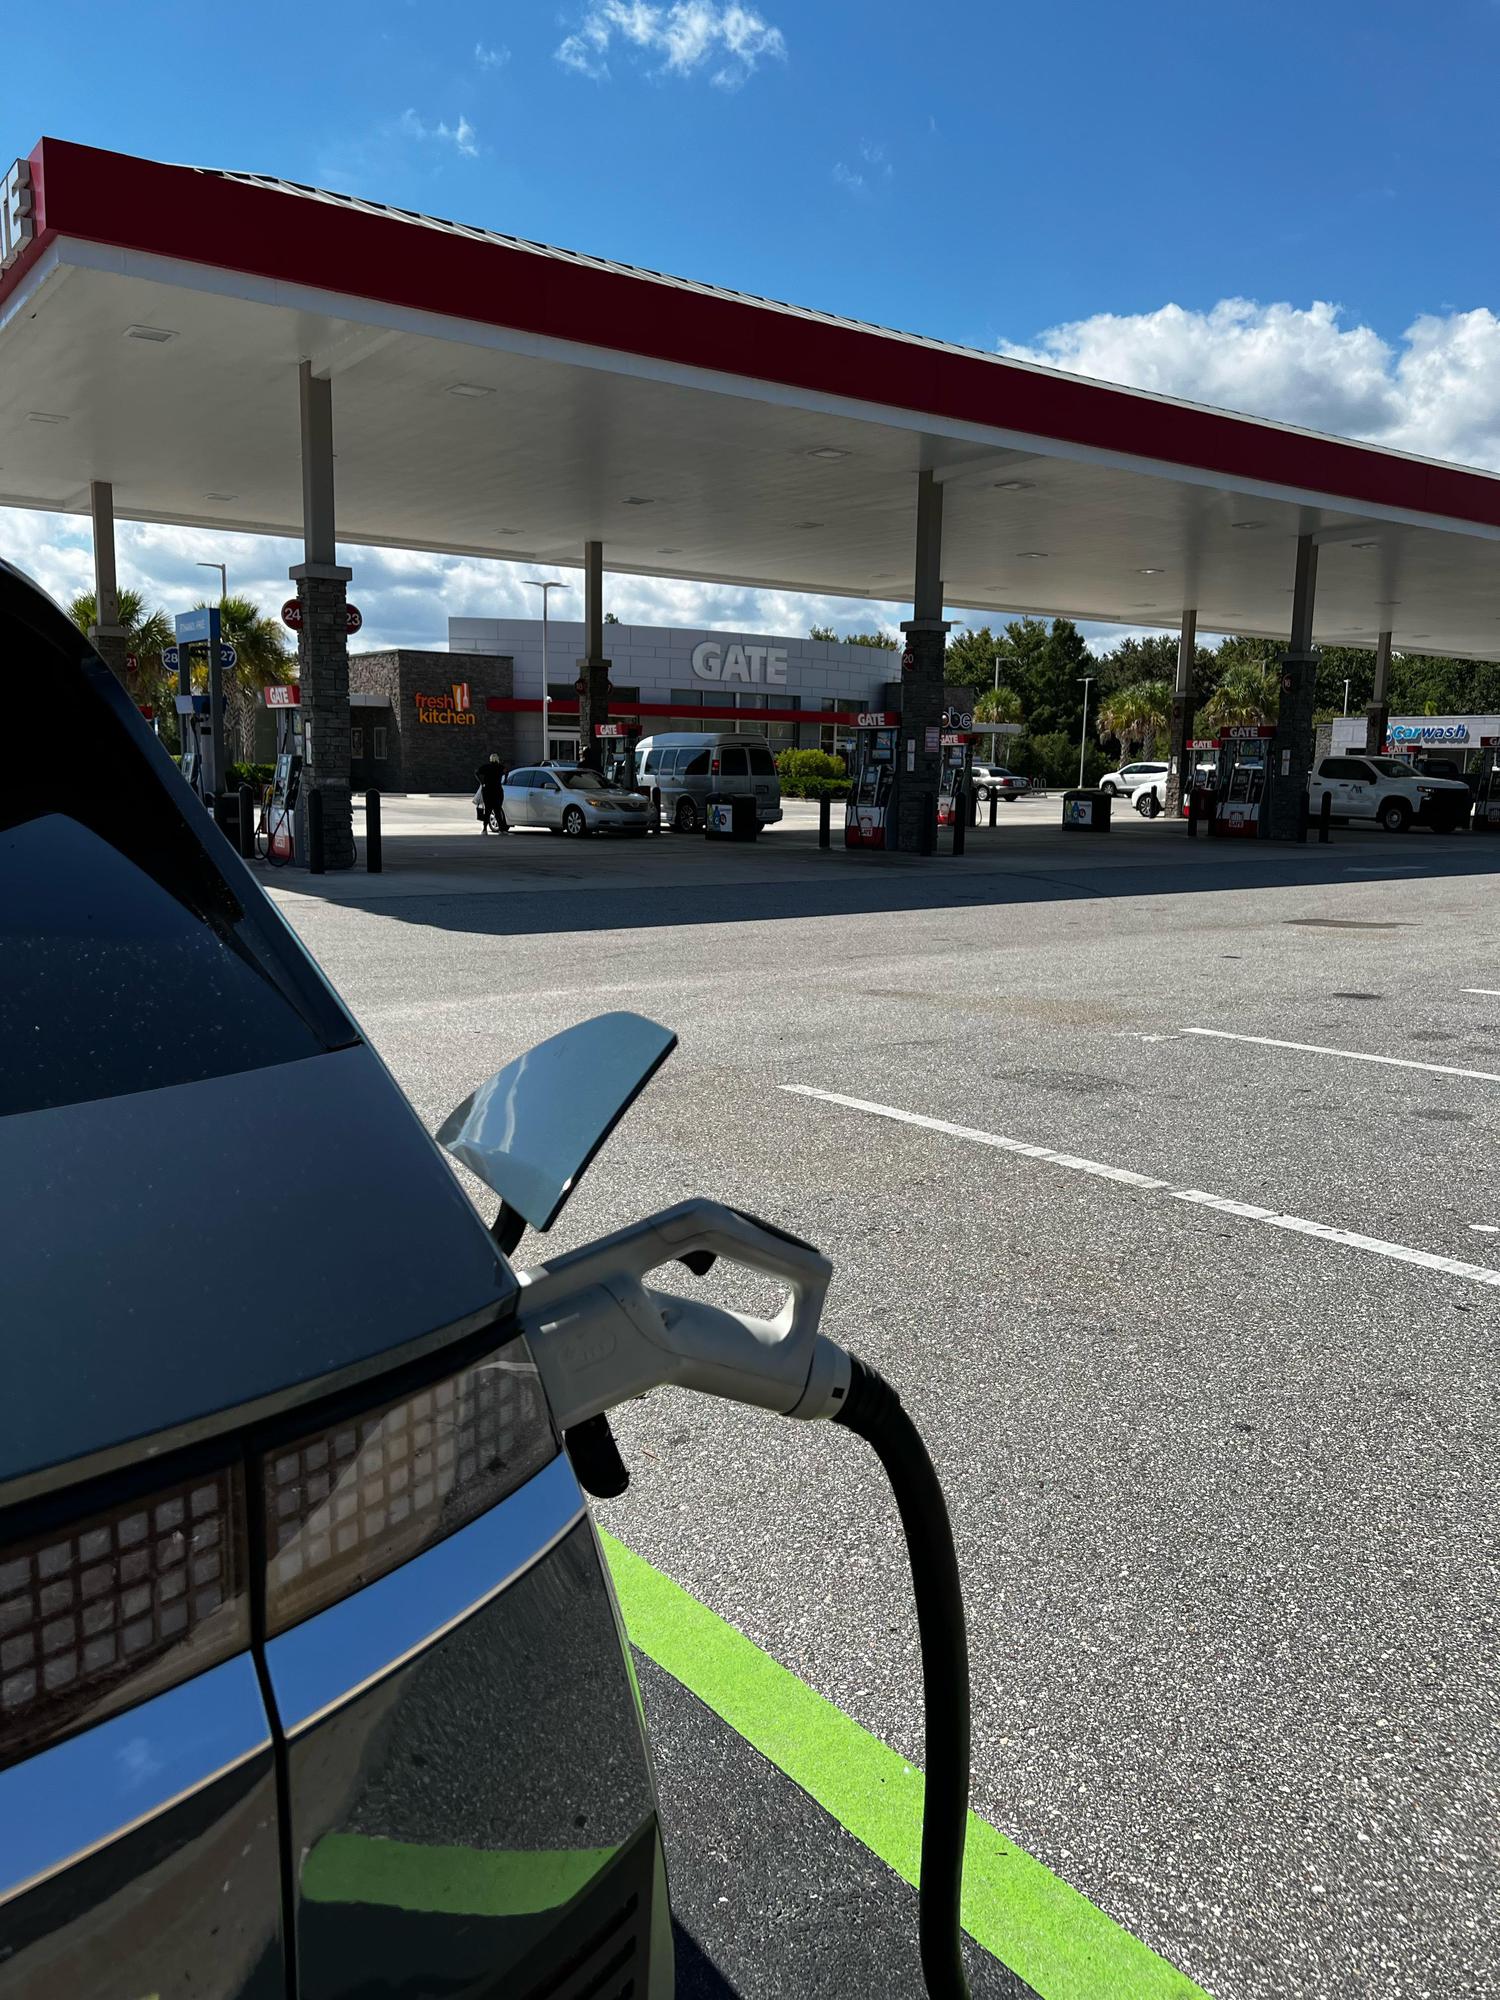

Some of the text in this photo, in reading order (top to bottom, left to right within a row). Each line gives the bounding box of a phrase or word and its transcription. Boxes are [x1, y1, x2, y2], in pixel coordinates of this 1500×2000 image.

[284, 607, 302, 621] 24
[346, 612, 360, 626] 23
[164, 652, 178, 663] 28
[221, 650, 235, 661] 27
[903, 654, 914, 664] 20
[692, 642, 788, 684] GATE
[269, 686, 290, 703] GATE
[415, 692, 453, 709] fresh
[419, 707, 476, 725] kitchen
[857, 712, 885, 726] GATE
[599, 724, 617, 735] GATE
[1229, 726, 1259, 737] GATE
[1392, 724, 1469, 740] Carwash
[1191, 739, 1213, 749] GATE
[1387, 745, 1408, 754] GATE
